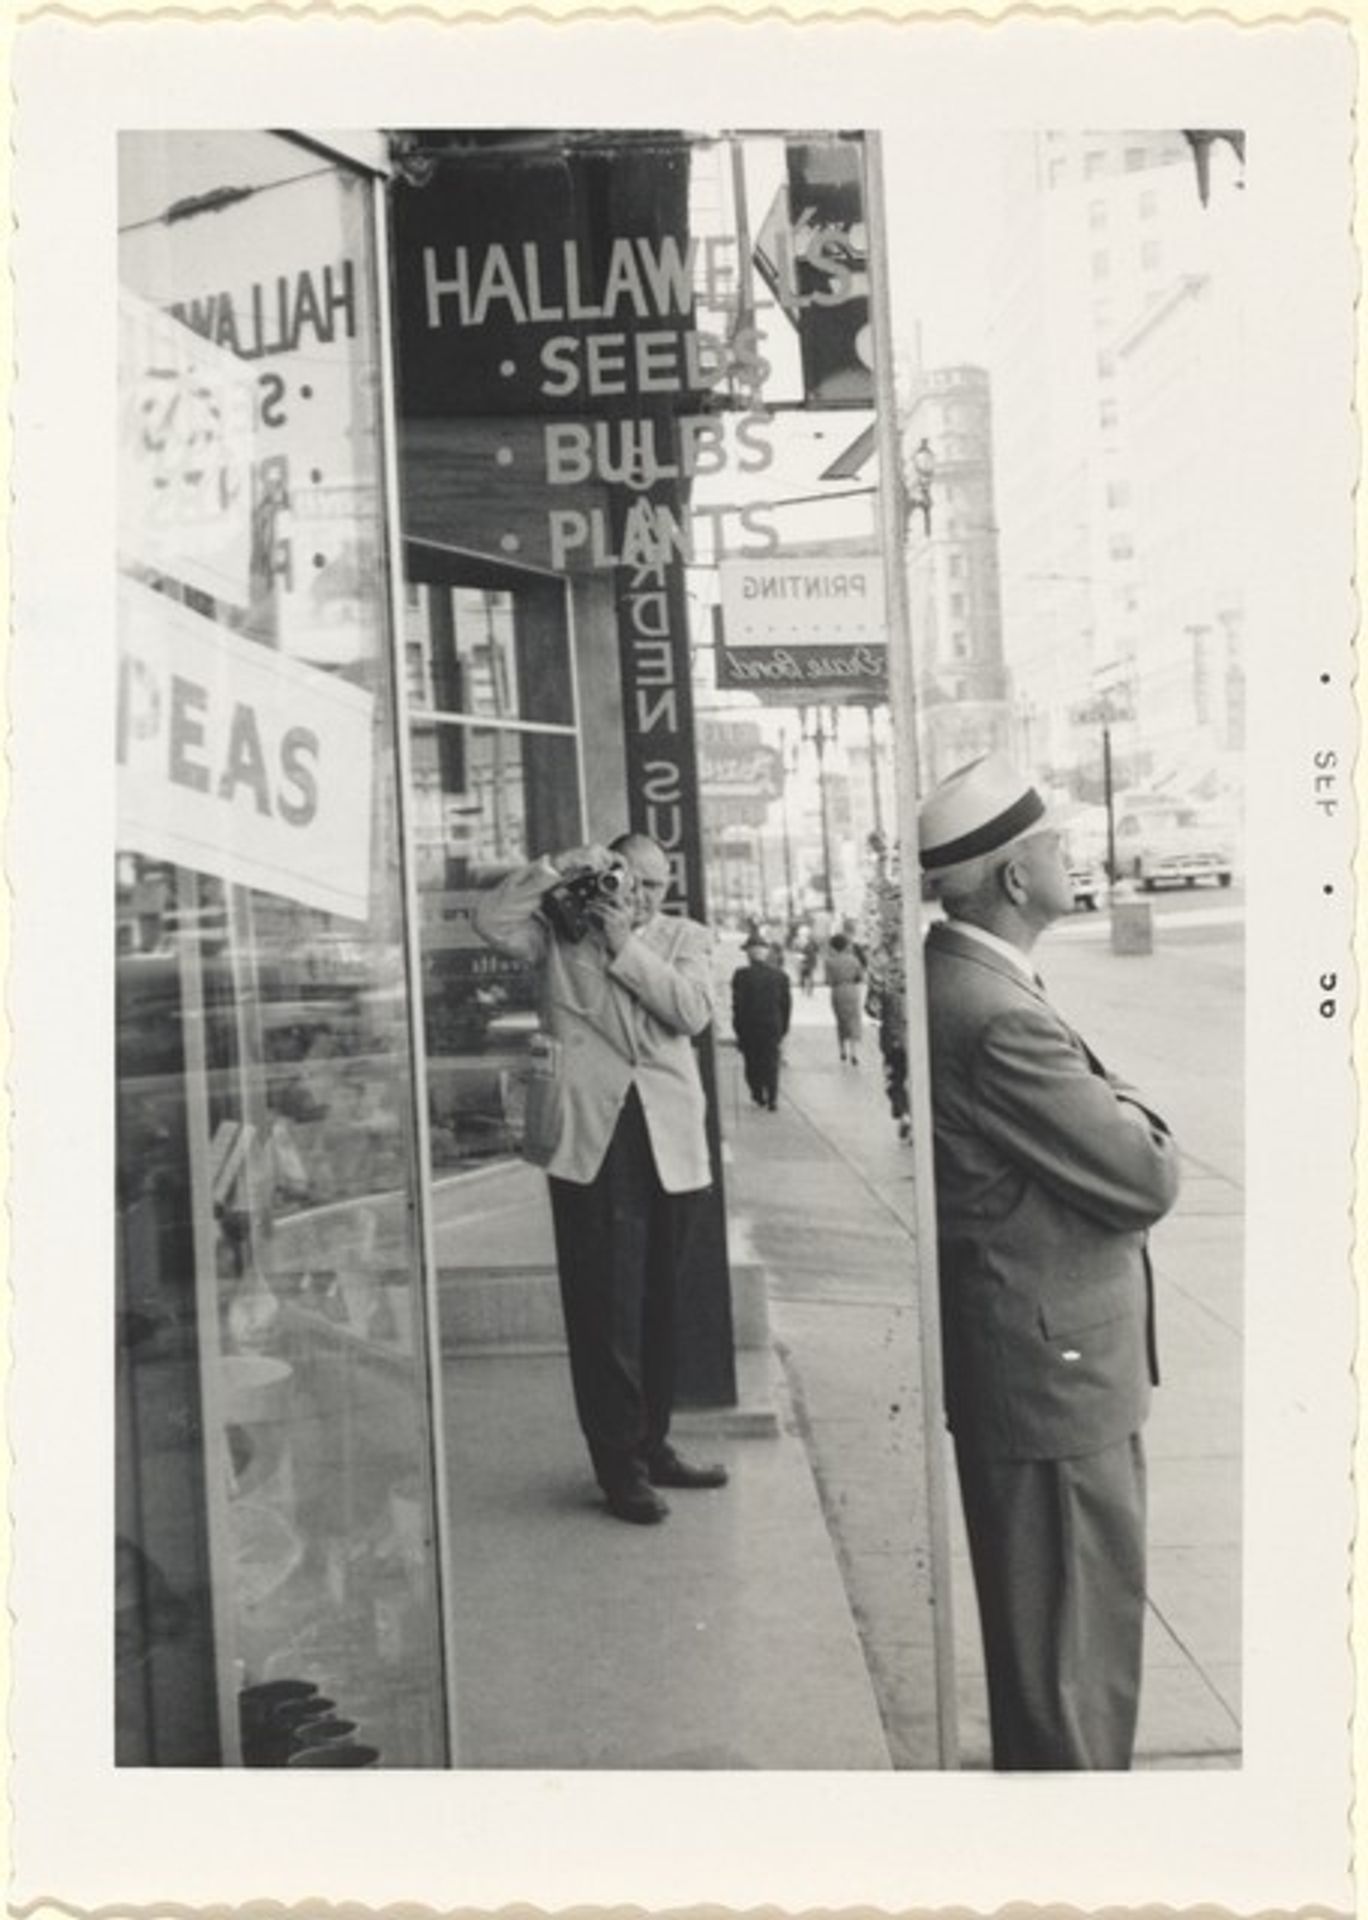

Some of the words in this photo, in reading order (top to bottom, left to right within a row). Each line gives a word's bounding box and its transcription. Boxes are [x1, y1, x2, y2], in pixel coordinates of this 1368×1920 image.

[539, 328, 771, 398] SEEDS
[543, 411, 775, 485] BULBS
[548, 502, 781, 571] PLANTS
[115, 652, 321, 829] PEAS
